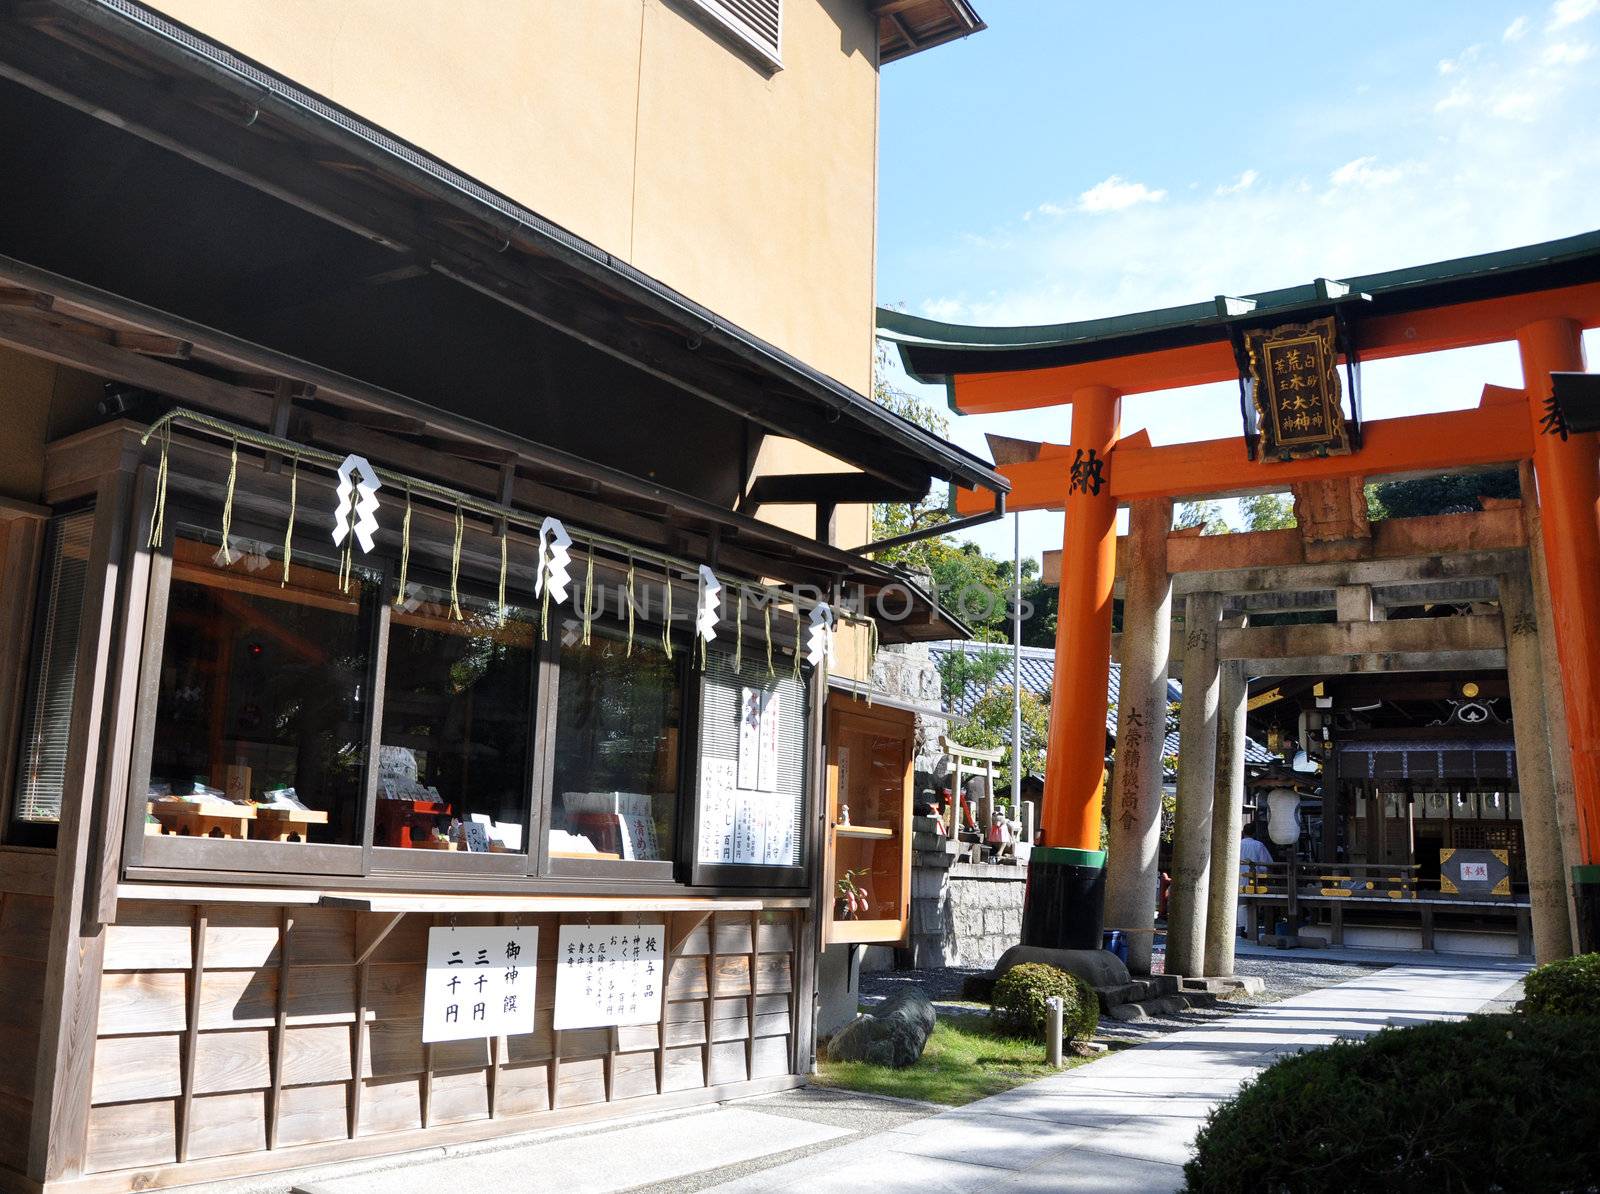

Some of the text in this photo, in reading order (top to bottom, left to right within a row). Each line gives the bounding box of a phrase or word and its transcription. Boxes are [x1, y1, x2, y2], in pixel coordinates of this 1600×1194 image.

[1287, 349, 1311, 431] 荒木大神
[1069, 448, 1106, 496] 納
[445, 950, 464, 1023] 二千円
[473, 949, 491, 1022] 三千円
[643, 936, 657, 998] 授与品
